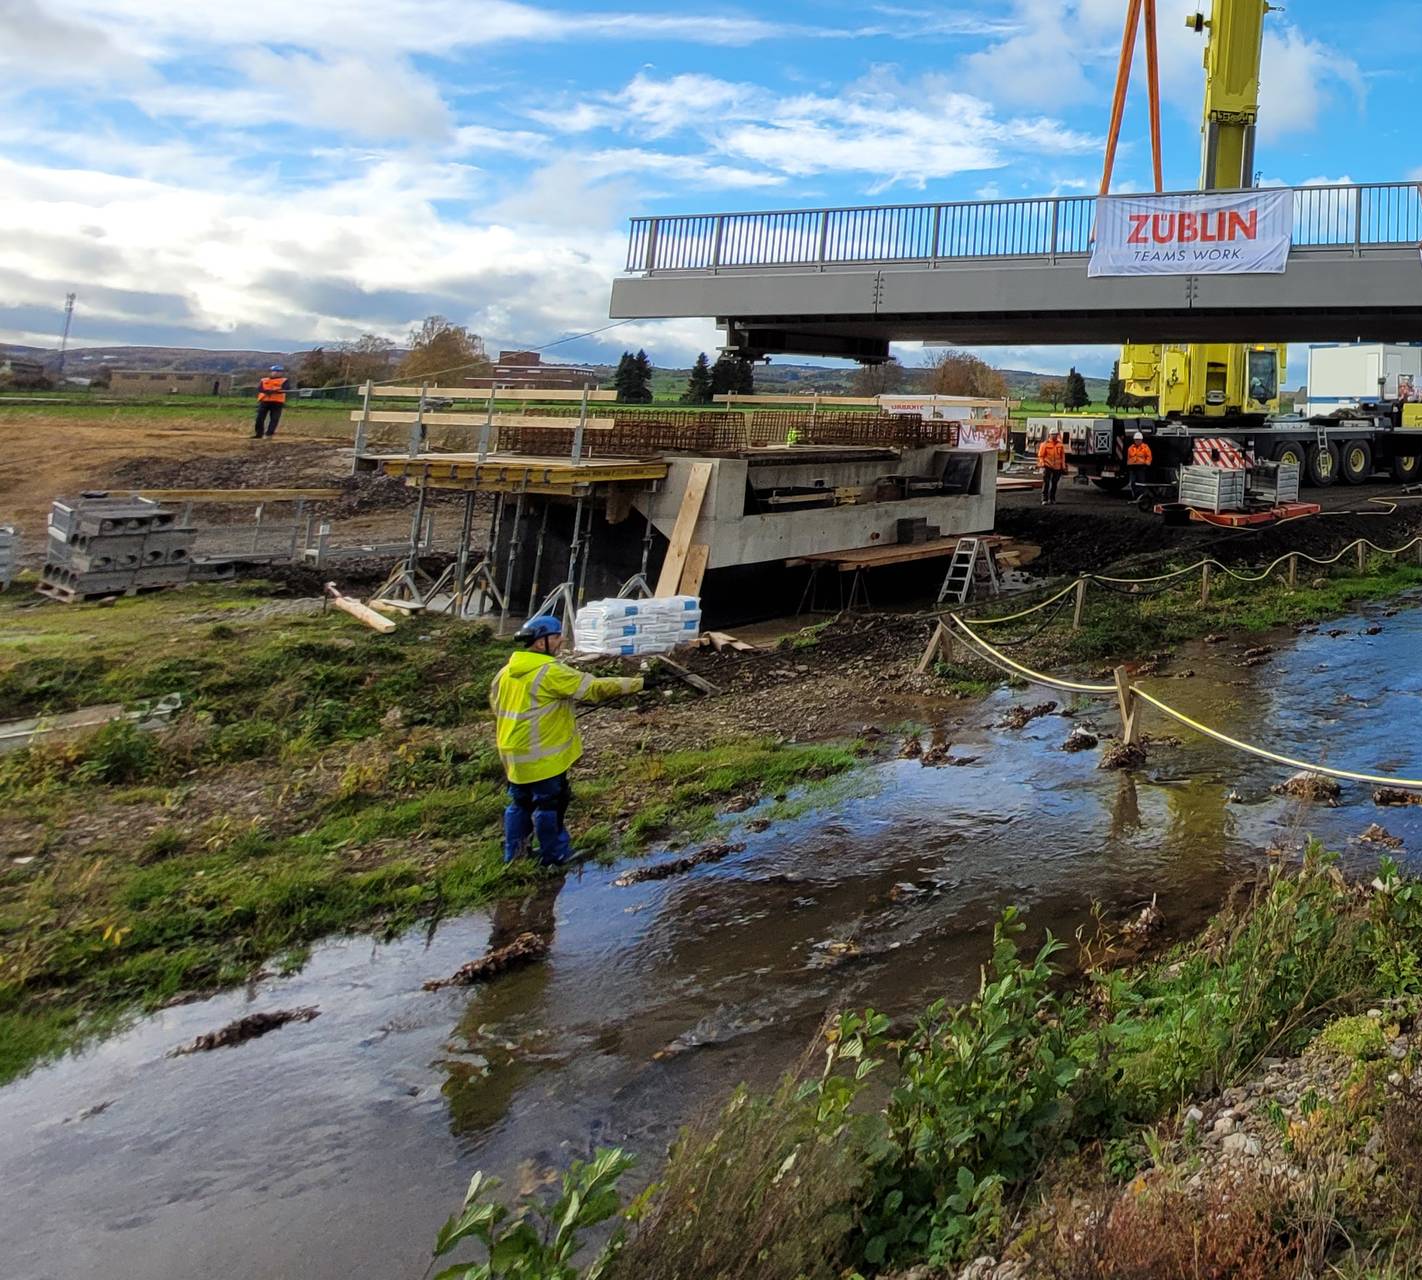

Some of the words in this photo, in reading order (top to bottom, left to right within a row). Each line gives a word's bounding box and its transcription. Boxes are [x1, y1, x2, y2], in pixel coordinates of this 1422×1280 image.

[1127, 208, 1258, 244] ZÜBLIN
[1135, 250, 1186, 262] TEAMS
[1193, 248, 1245, 260] WORK.
